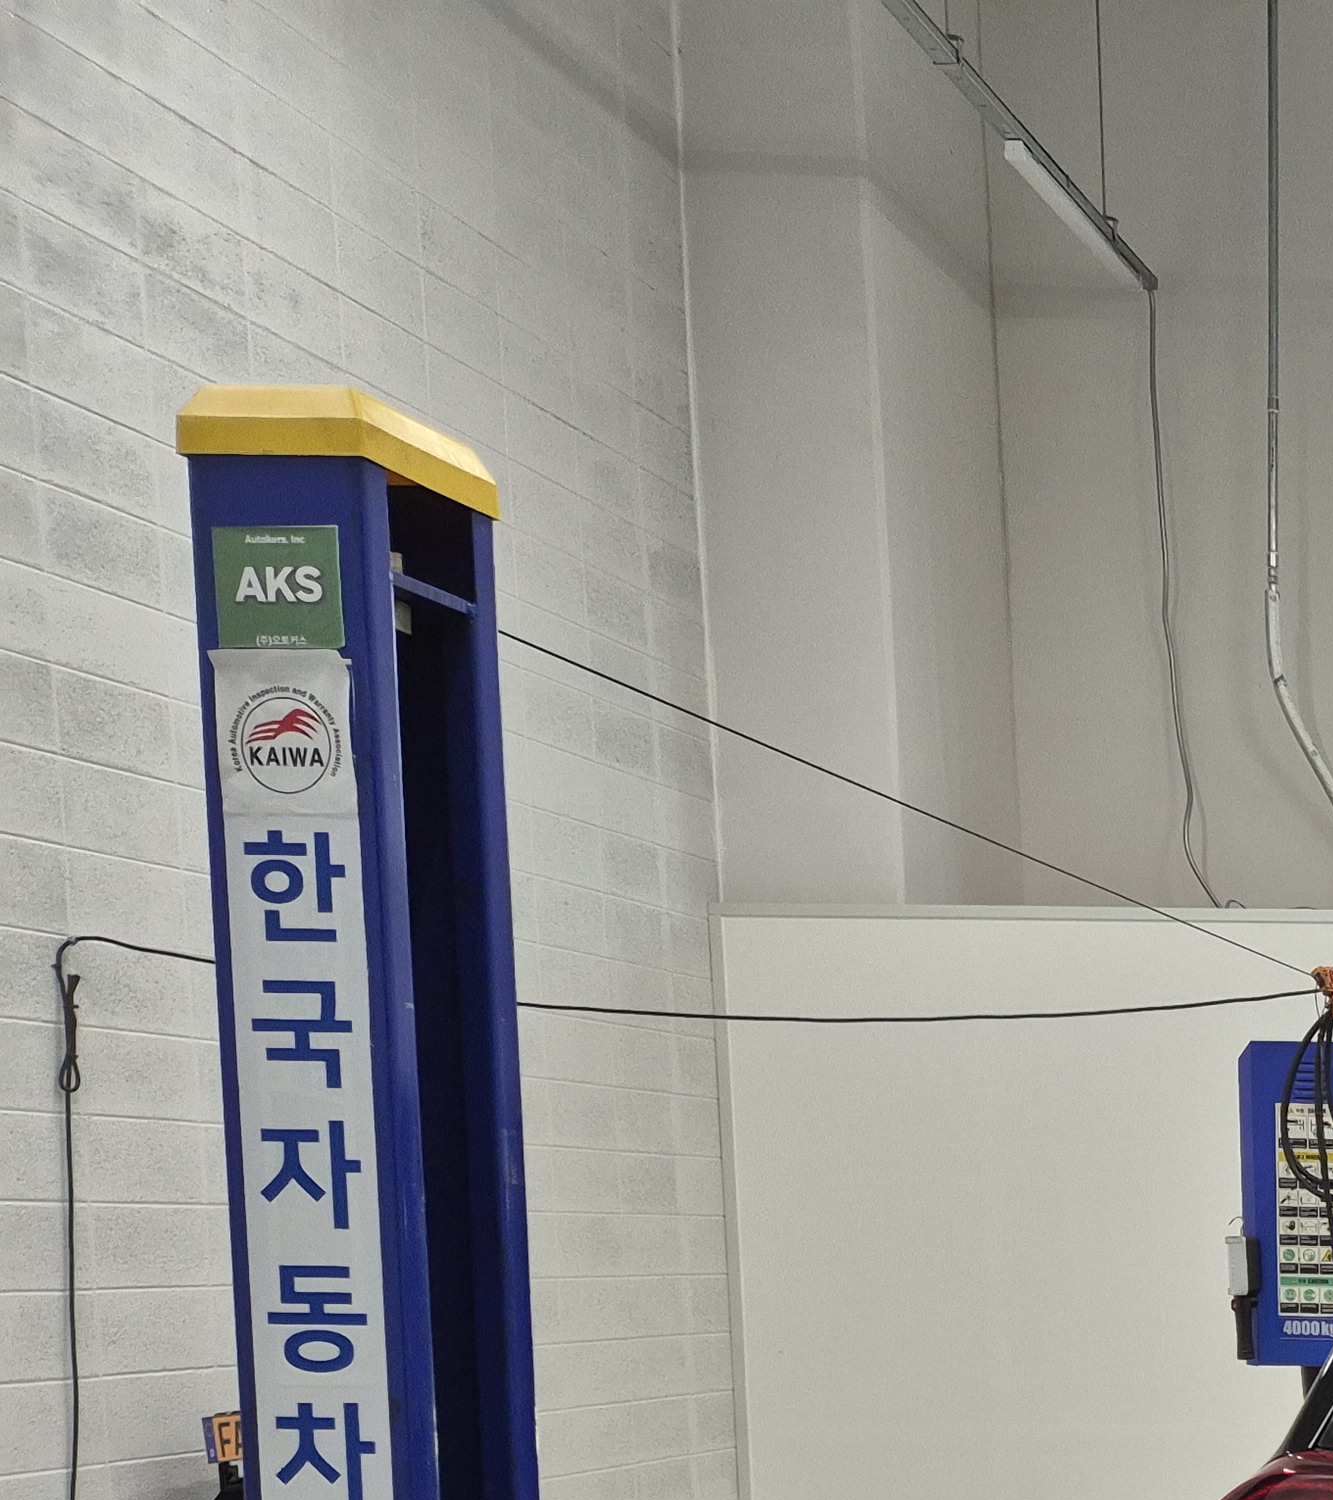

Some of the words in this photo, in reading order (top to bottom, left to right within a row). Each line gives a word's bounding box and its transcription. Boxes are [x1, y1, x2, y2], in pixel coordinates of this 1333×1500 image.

[235, 566, 323, 602] AKS
[248, 685, 290, 703] Inspection
[291, 687, 307, 698] and
[308, 693, 336, 726] Warranty
[249, 746, 325, 768] KAIWA
